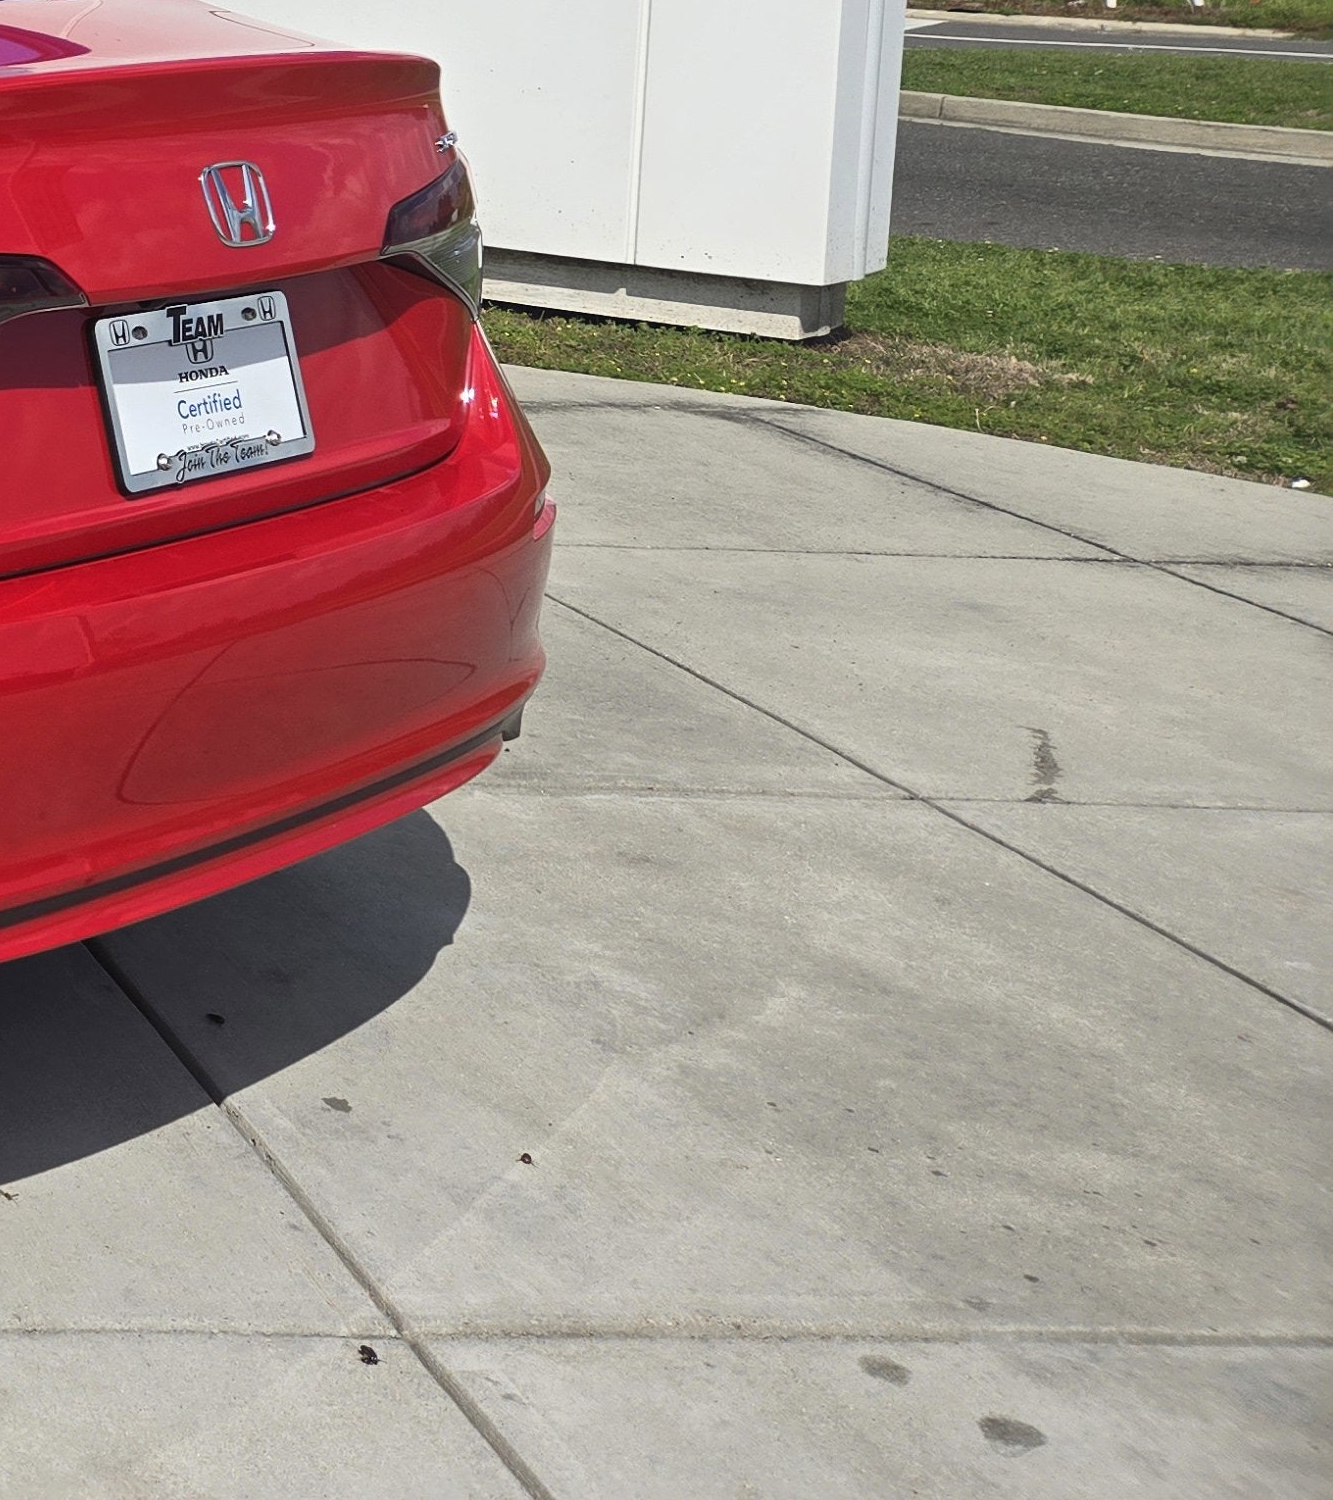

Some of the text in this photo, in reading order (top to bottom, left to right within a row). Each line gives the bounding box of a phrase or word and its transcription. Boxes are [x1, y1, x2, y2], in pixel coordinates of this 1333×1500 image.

[166, 305, 224, 344] TEAM
[178, 365, 230, 383] HONDA
[177, 388, 242, 419] Certified
[182, 412, 245, 434] Pre-Owned
[176, 451, 206, 482] Join
[205, 445, 230, 468] The
